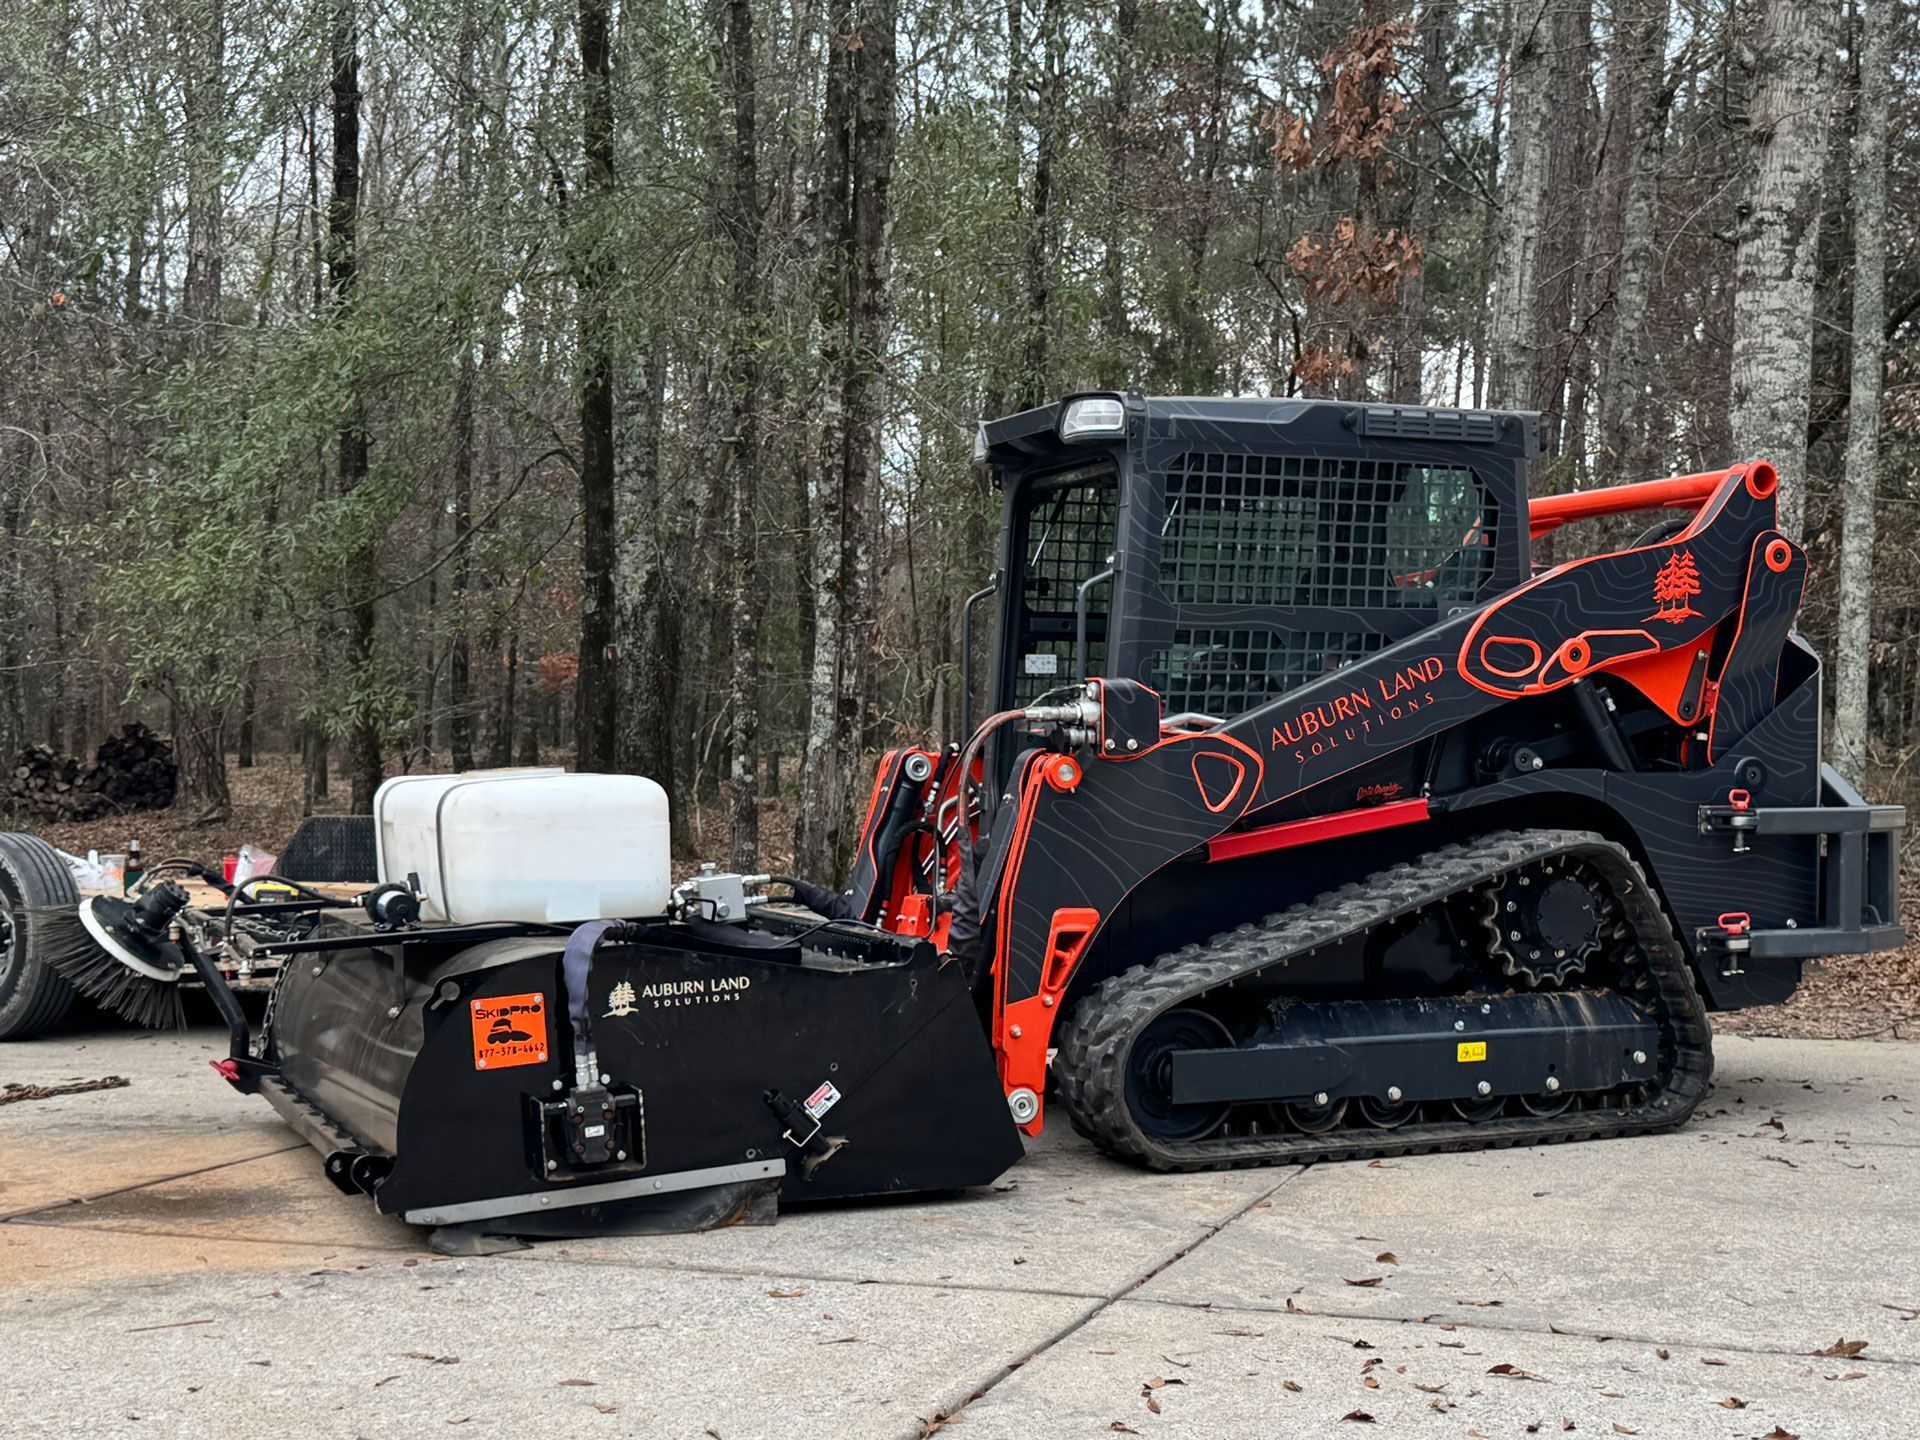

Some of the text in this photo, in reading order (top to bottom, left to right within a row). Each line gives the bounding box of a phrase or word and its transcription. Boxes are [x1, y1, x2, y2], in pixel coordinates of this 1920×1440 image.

[1271, 656, 1444, 751] AUBURN LAND
[1294, 691, 1435, 764] SOLUTIONS
[641, 976, 751, 999] AUBURN LAND
[653, 992, 741, 1009] SOLUTIONS
